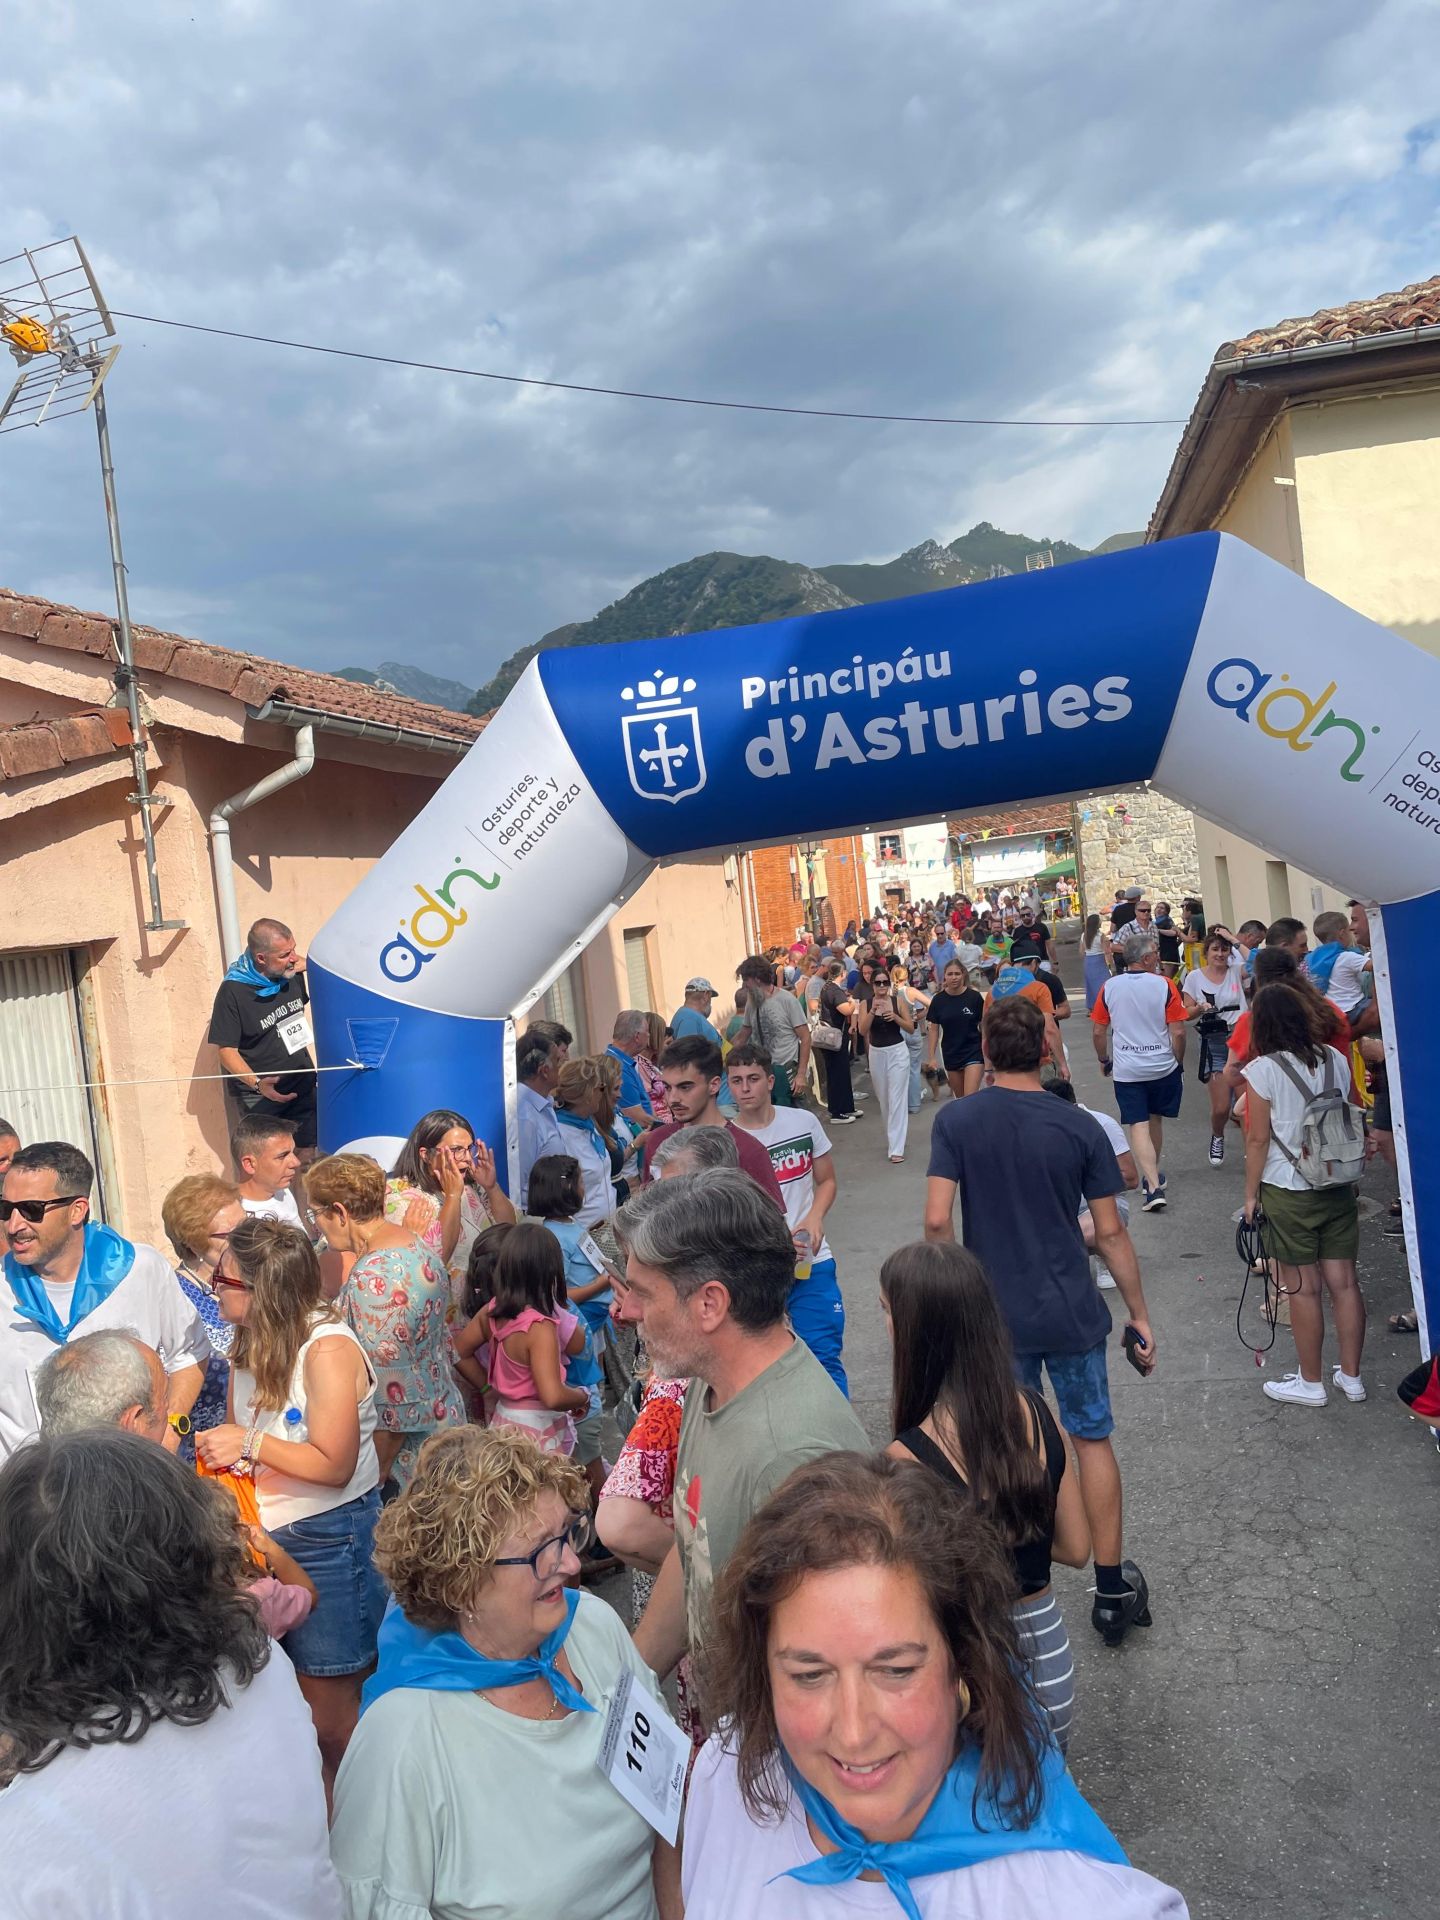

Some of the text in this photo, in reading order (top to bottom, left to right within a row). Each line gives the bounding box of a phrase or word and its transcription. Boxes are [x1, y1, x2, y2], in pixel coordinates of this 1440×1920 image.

[742, 646, 951, 709] Principáu
[745, 669, 1133, 779] d'Asturies
[482, 774, 538, 832] asturies,
[498, 777, 558, 845] deporte y
[1402, 774, 1440, 805] dep
[513, 783, 581, 860] naturaleza
[286, 1023, 303, 1037] 023
[626, 1711, 651, 1773] 110
